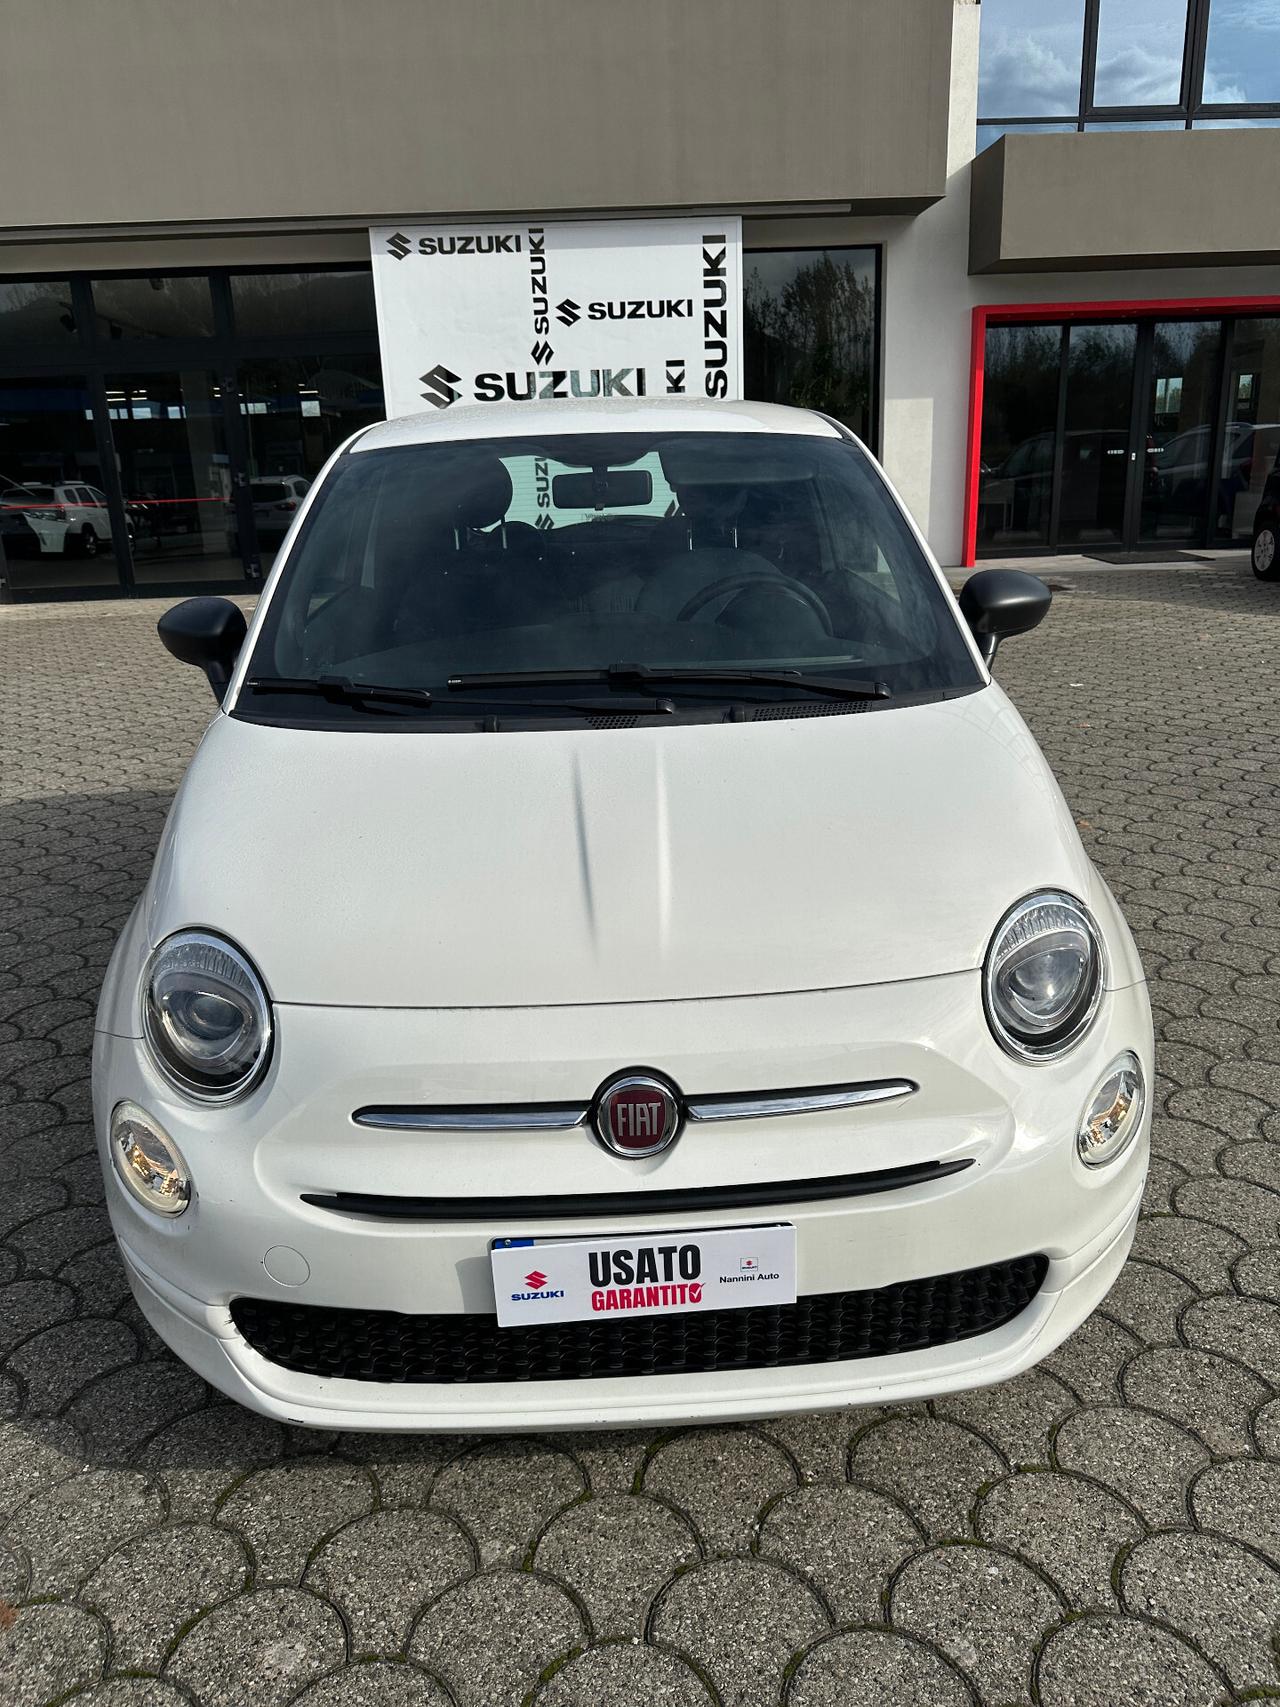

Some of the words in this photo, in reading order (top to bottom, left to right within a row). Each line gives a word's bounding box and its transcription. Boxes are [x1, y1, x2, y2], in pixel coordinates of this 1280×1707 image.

[418, 234, 522, 255] SUZUKI
[528, 227, 549, 335] SUZUKI
[587, 299, 693, 321] SUZUKI
[702, 234, 728, 399] SUZUKI
[473, 367, 647, 402] SUZUKI
[616, 1101, 662, 1137] FIAT
[588, 1244, 701, 1288] USATO
[719, 1273, 755, 1284] Nannini
[757, 1272, 780, 1281] Auto
[511, 1290, 565, 1302] SUZUKI
[591, 1282, 705, 1312] GARANTITO
